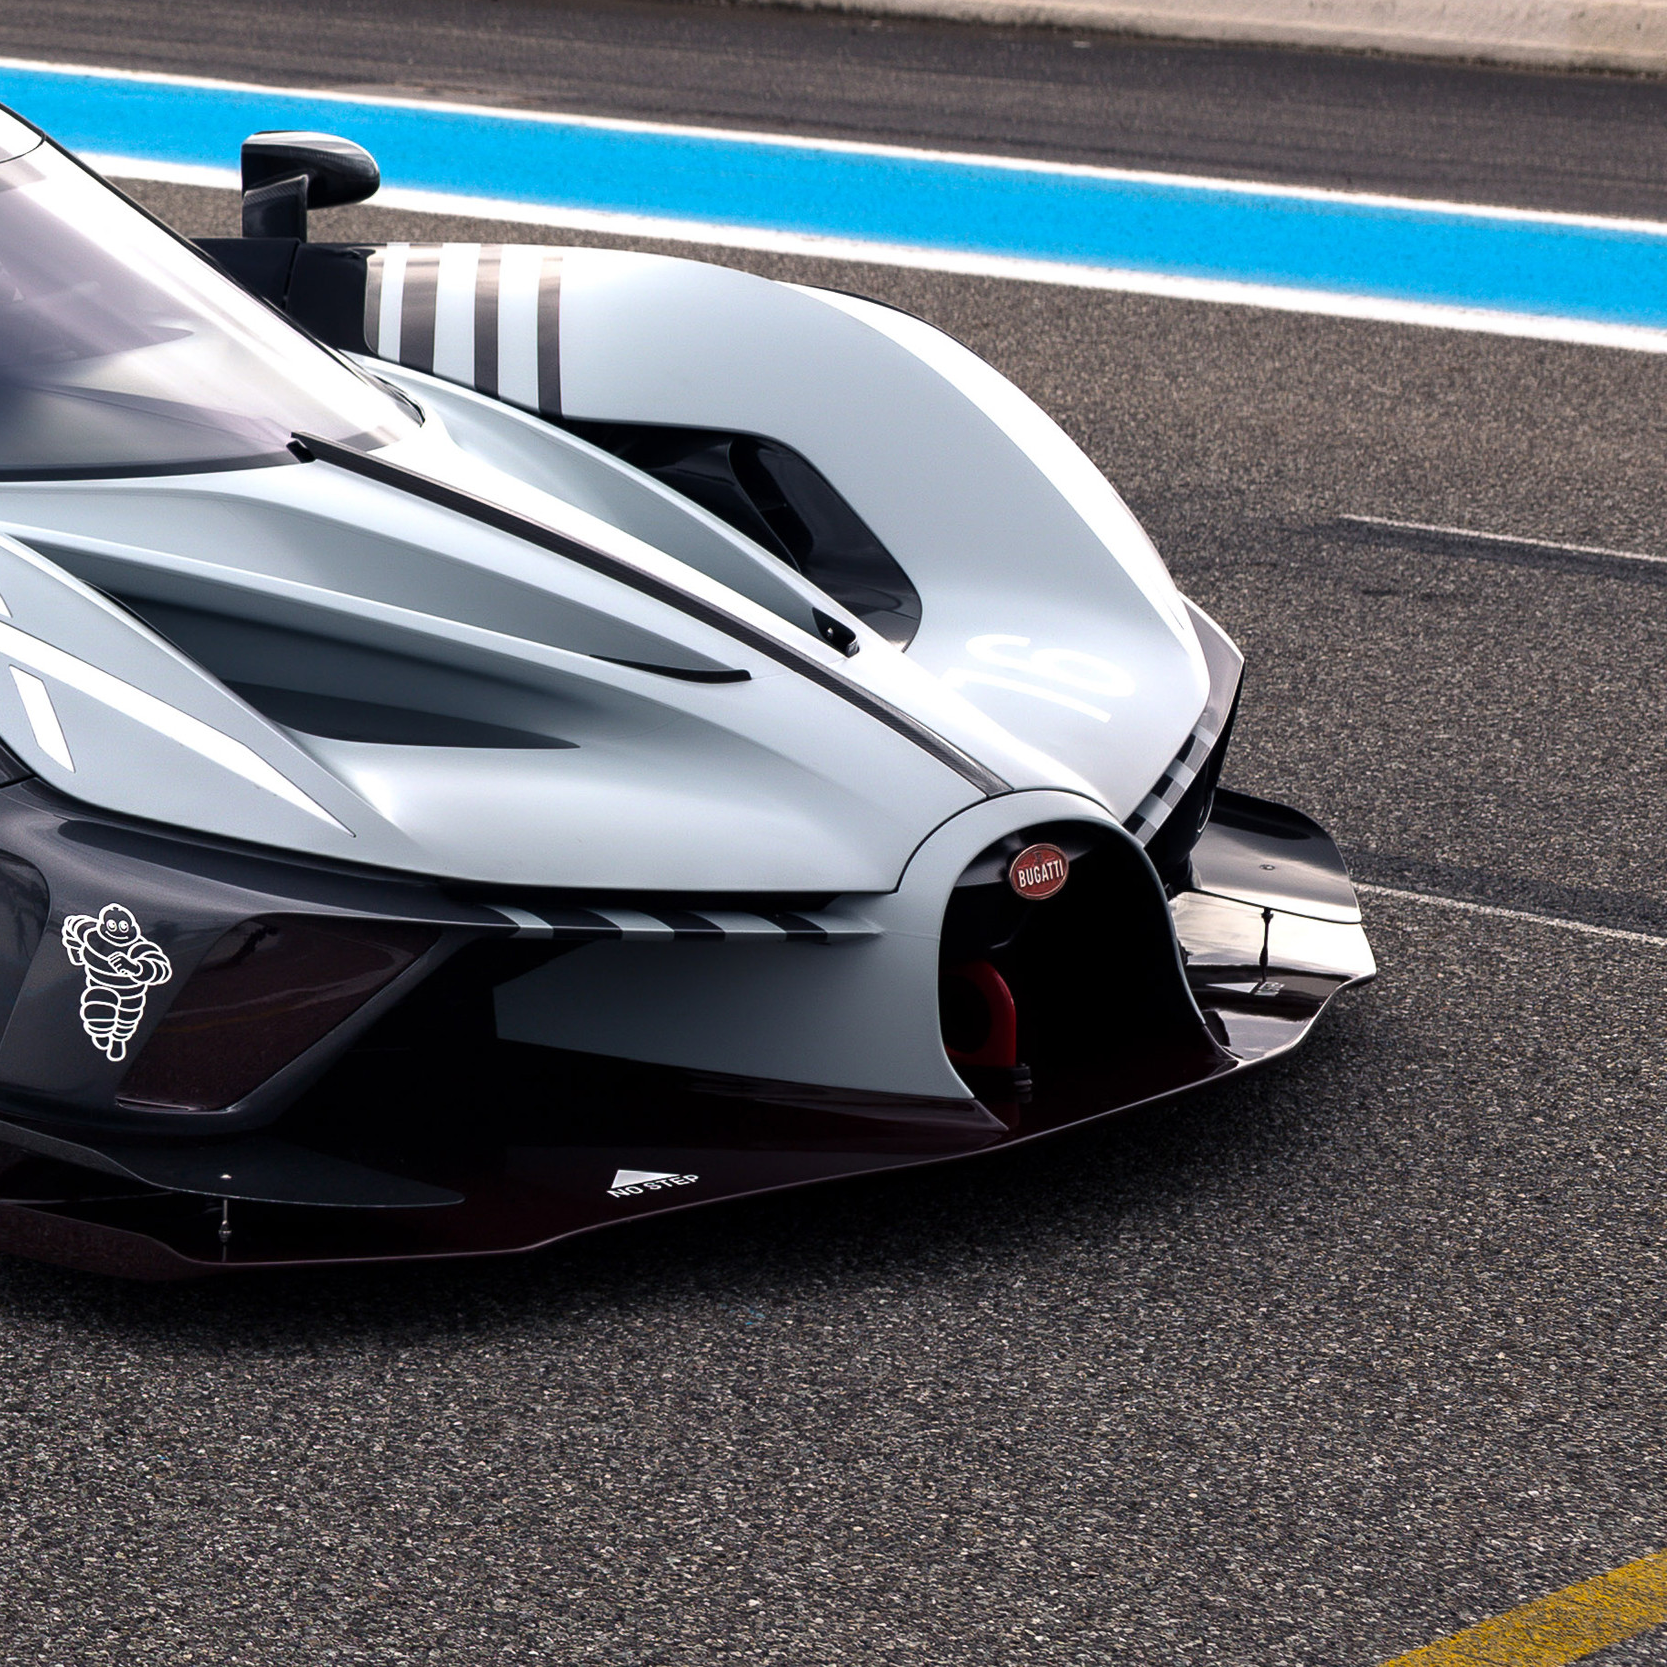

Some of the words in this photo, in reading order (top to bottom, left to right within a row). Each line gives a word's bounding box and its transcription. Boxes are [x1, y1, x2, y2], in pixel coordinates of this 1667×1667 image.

[1018, 859, 1064, 888] BUGATTI
[607, 1185, 643, 1198] NO
[643, 1174, 699, 1190] STEP
